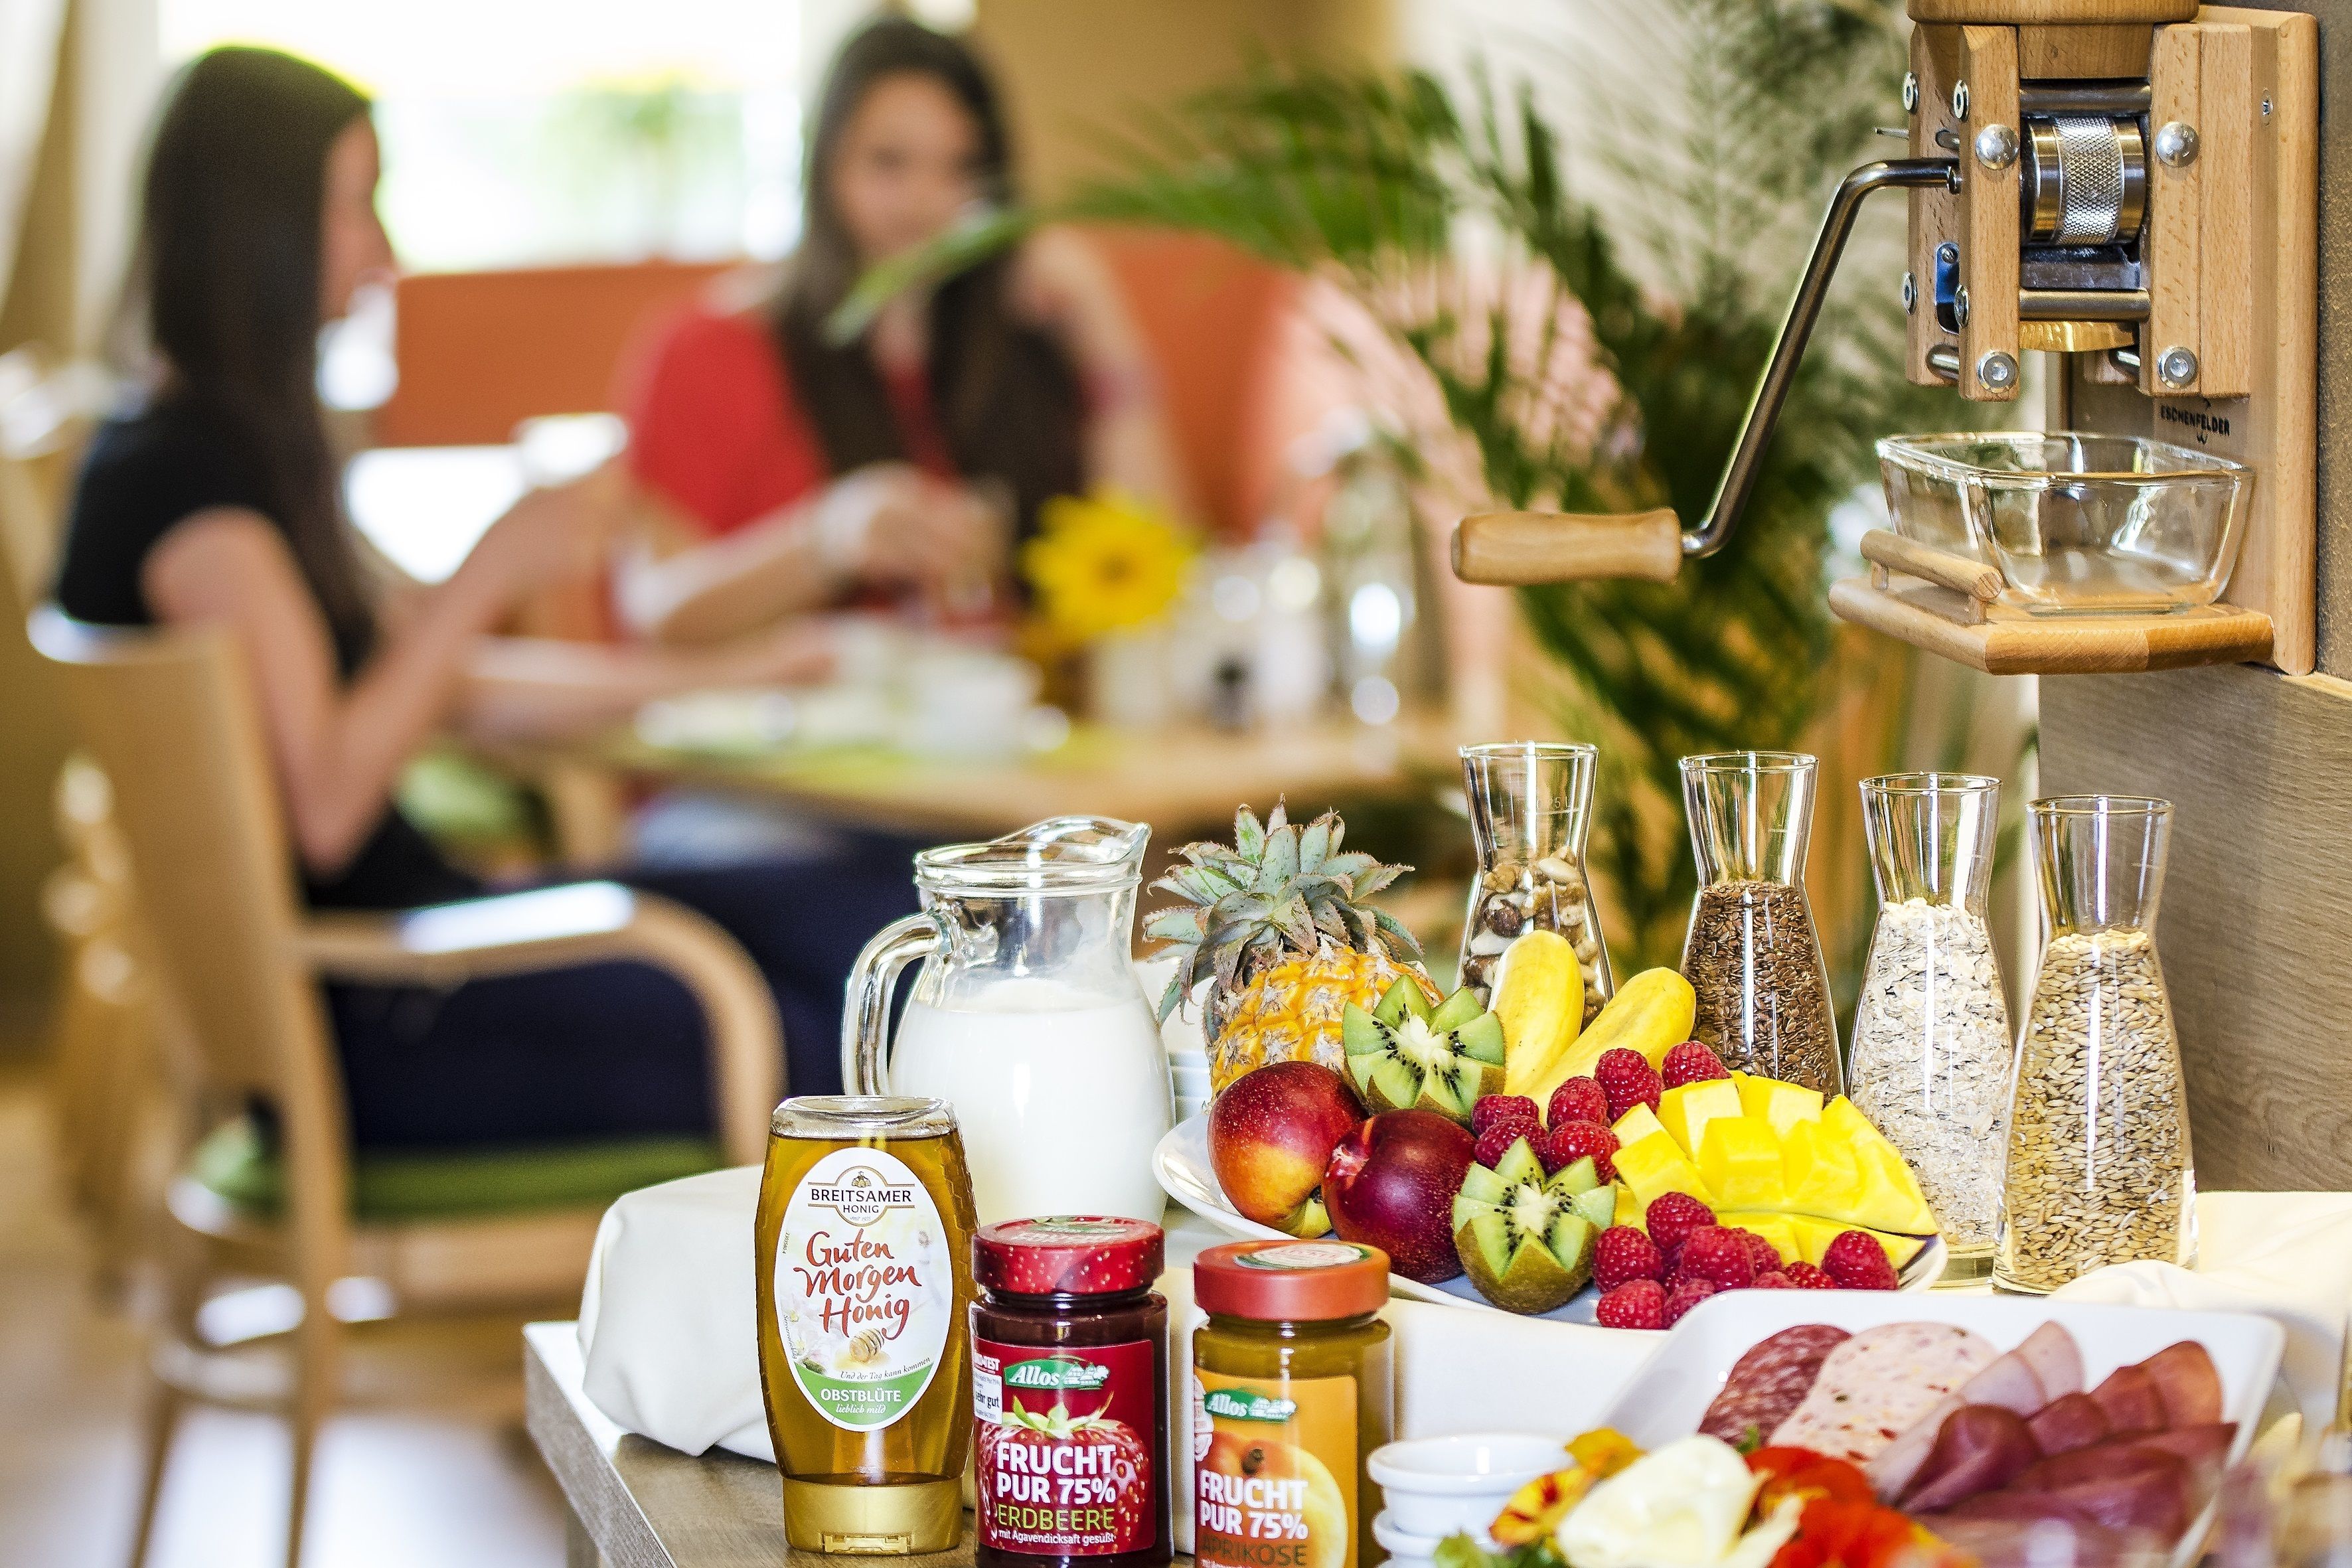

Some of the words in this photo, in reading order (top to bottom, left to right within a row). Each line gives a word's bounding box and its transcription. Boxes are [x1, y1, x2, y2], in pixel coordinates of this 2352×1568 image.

[2160, 404, 2230, 436] ESCHENFELDER
[812, 1189, 912, 1202] BREITSAMER
[807, 1228, 894, 1267] Guten
[793, 1265, 922, 1303] Morgen
[819, 1294, 909, 1340] Honig
[840, 1370, 856, 1379] Und
[857, 1372, 868, 1380] der
[870, 1372, 882, 1381] Tag
[884, 1370, 902, 1378] kann
[903, 1357, 931, 1375] kommen
[1008, 1365, 1060, 1386] Allos
[821, 1387, 902, 1402] OBSTBLÜTE
[987, 1397, 1000, 1409] gut
[1206, 1393, 1248, 1417] Allos
[836, 1403, 865, 1414] lieblich
[866, 1403, 886, 1414] mild
[997, 1441, 1117, 1475] FRUCHT
[997, 1471, 1051, 1504] PUR
[1057, 1478, 1117, 1504] 75%
[1200, 1469, 1309, 1510] FRUCHT
[998, 1504, 1115, 1531] ERDBEERE
[1200, 1500, 1243, 1535] PUR
[1247, 1510, 1308, 1539] 75%
[998, 1529, 1011, 1540] mit
[1012, 1530, 1081, 1545] Agavendicksaft
[1082, 1531, 1115, 1547] gesüßt
